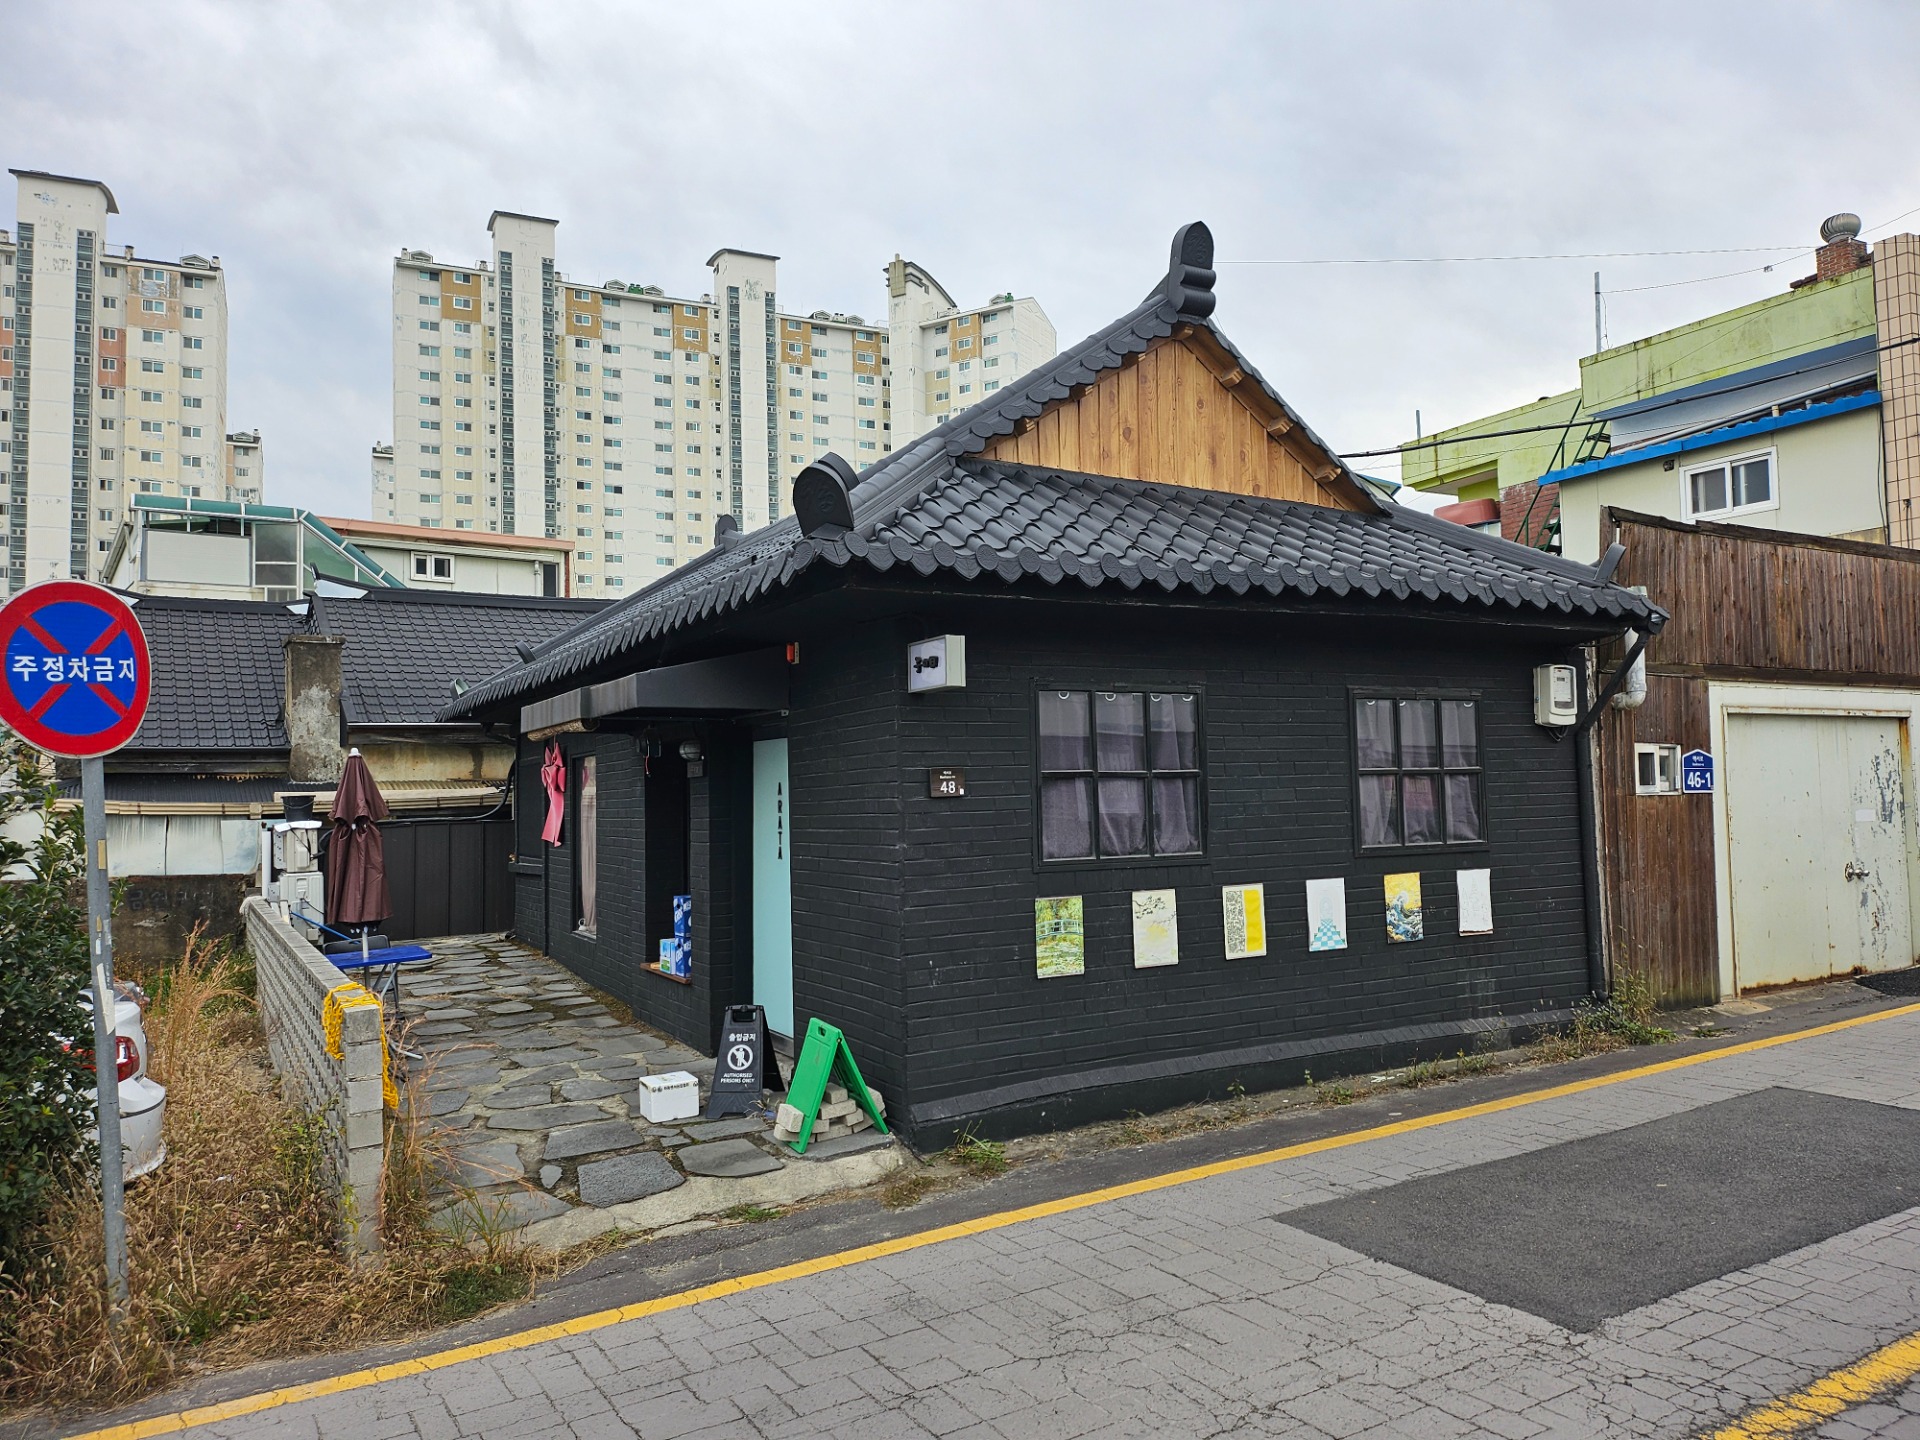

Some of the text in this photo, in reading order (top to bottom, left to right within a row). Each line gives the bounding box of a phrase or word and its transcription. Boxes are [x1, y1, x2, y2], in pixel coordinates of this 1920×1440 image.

[12, 655, 135, 682] 주정차금지
[1687, 771, 1711, 788] 46-1
[940, 781, 956, 794] 48
[728, 1033, 756, 1042] 출입금지
